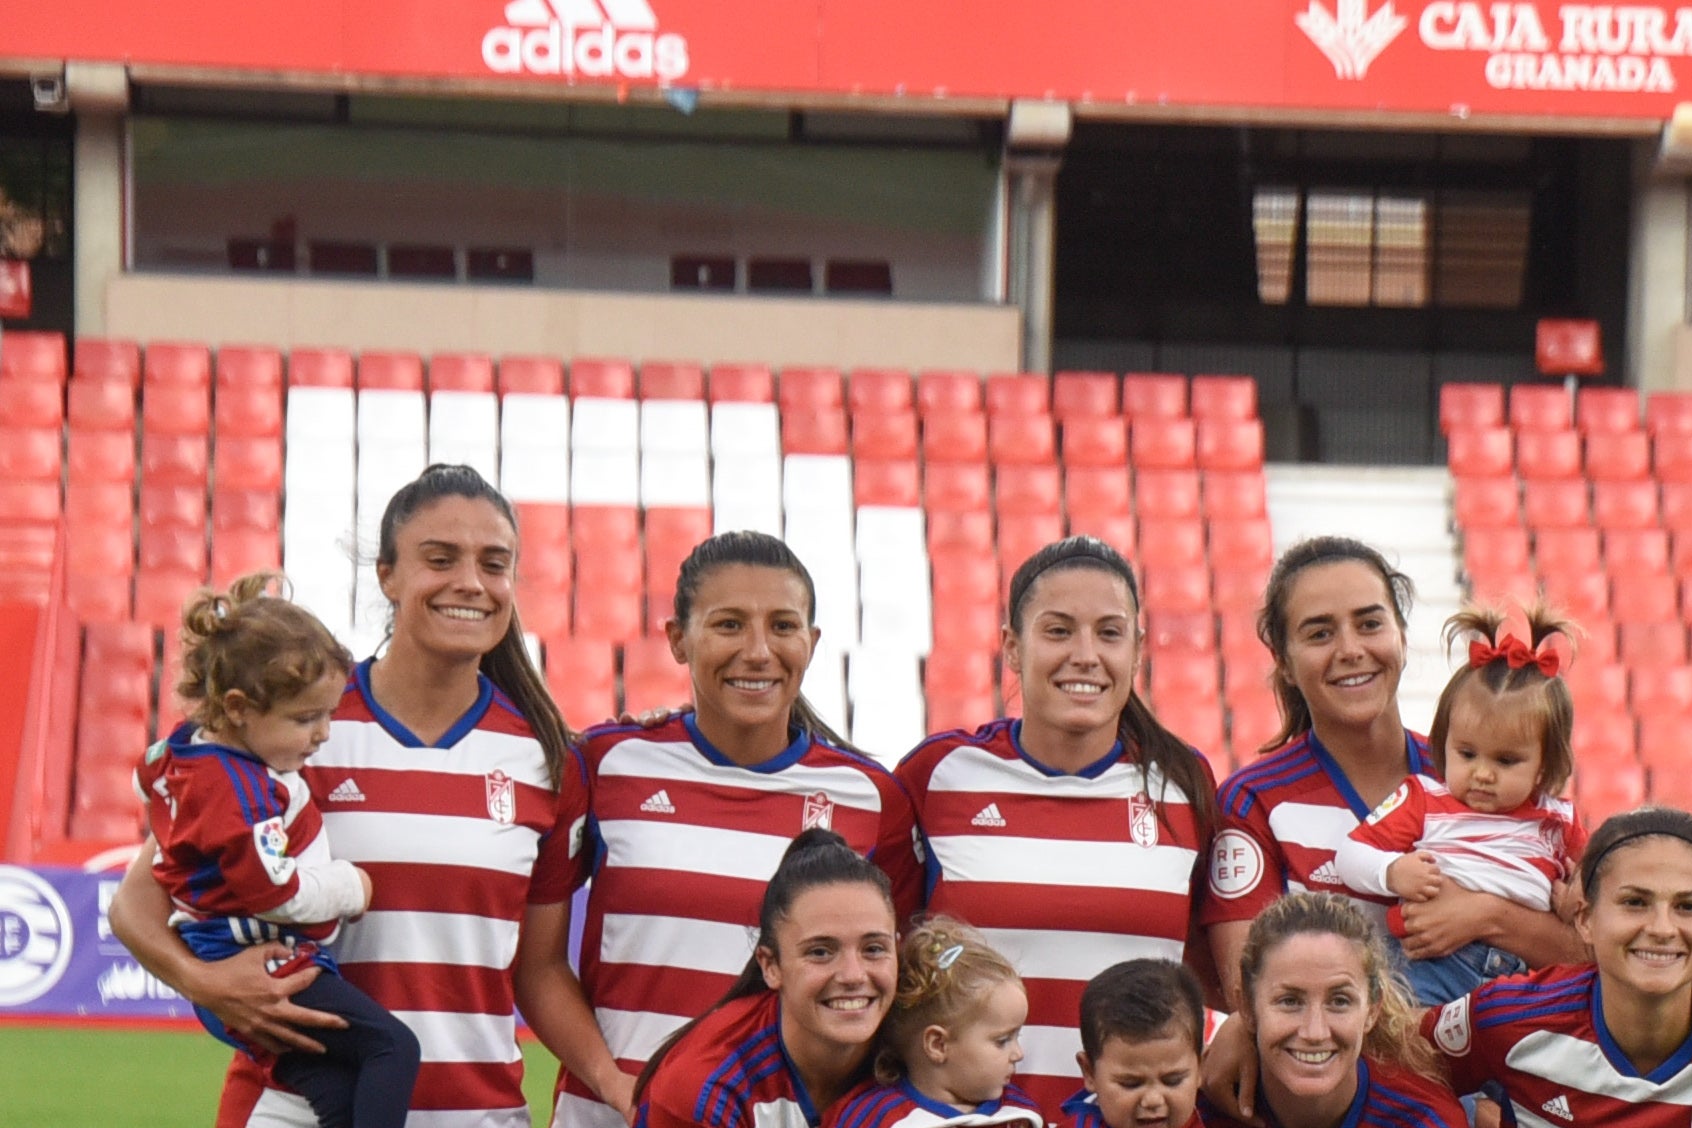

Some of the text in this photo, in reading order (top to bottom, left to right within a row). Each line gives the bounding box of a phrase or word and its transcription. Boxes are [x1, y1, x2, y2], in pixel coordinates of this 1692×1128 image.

[481, 21, 690, 79] adidas
[1419, 3, 1549, 51] CAJA
[1485, 52, 1677, 93] GRANADA
